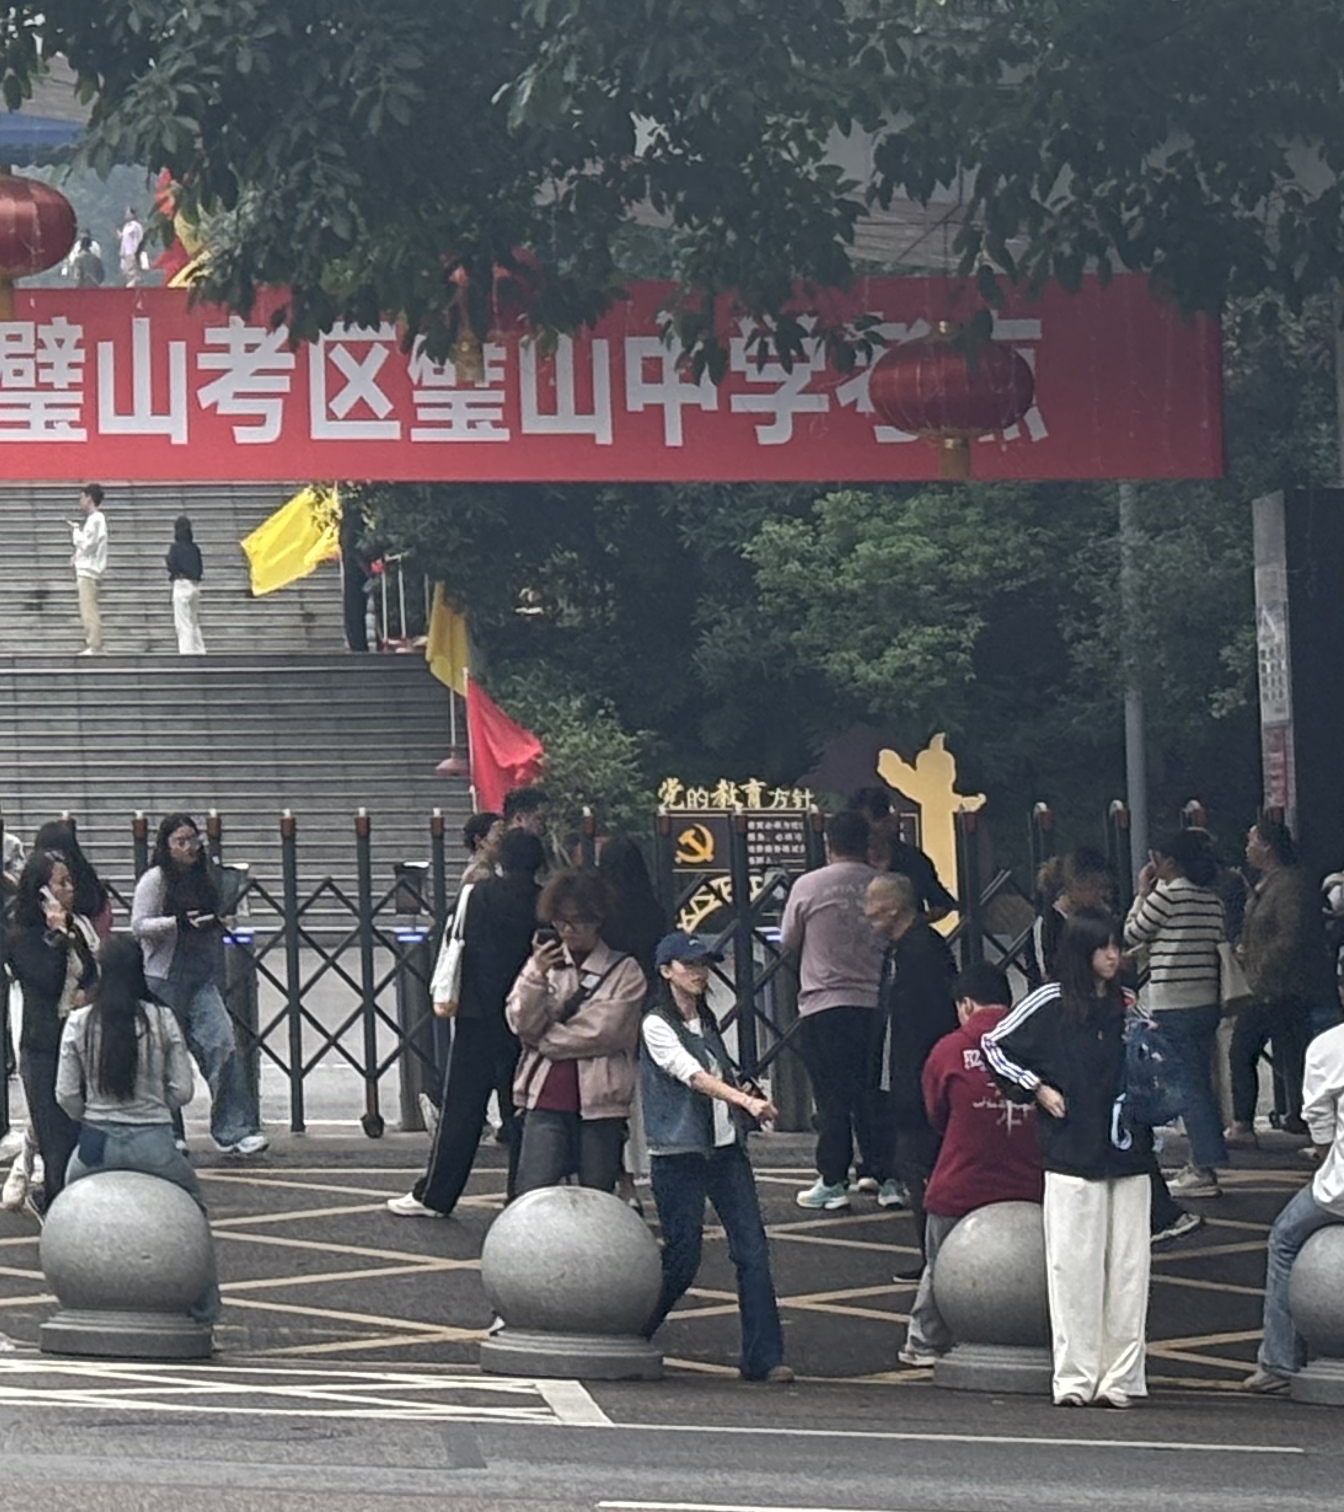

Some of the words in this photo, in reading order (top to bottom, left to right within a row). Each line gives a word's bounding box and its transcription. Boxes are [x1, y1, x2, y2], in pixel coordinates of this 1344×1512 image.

[658, 777, 815, 809] 党的教育方针
